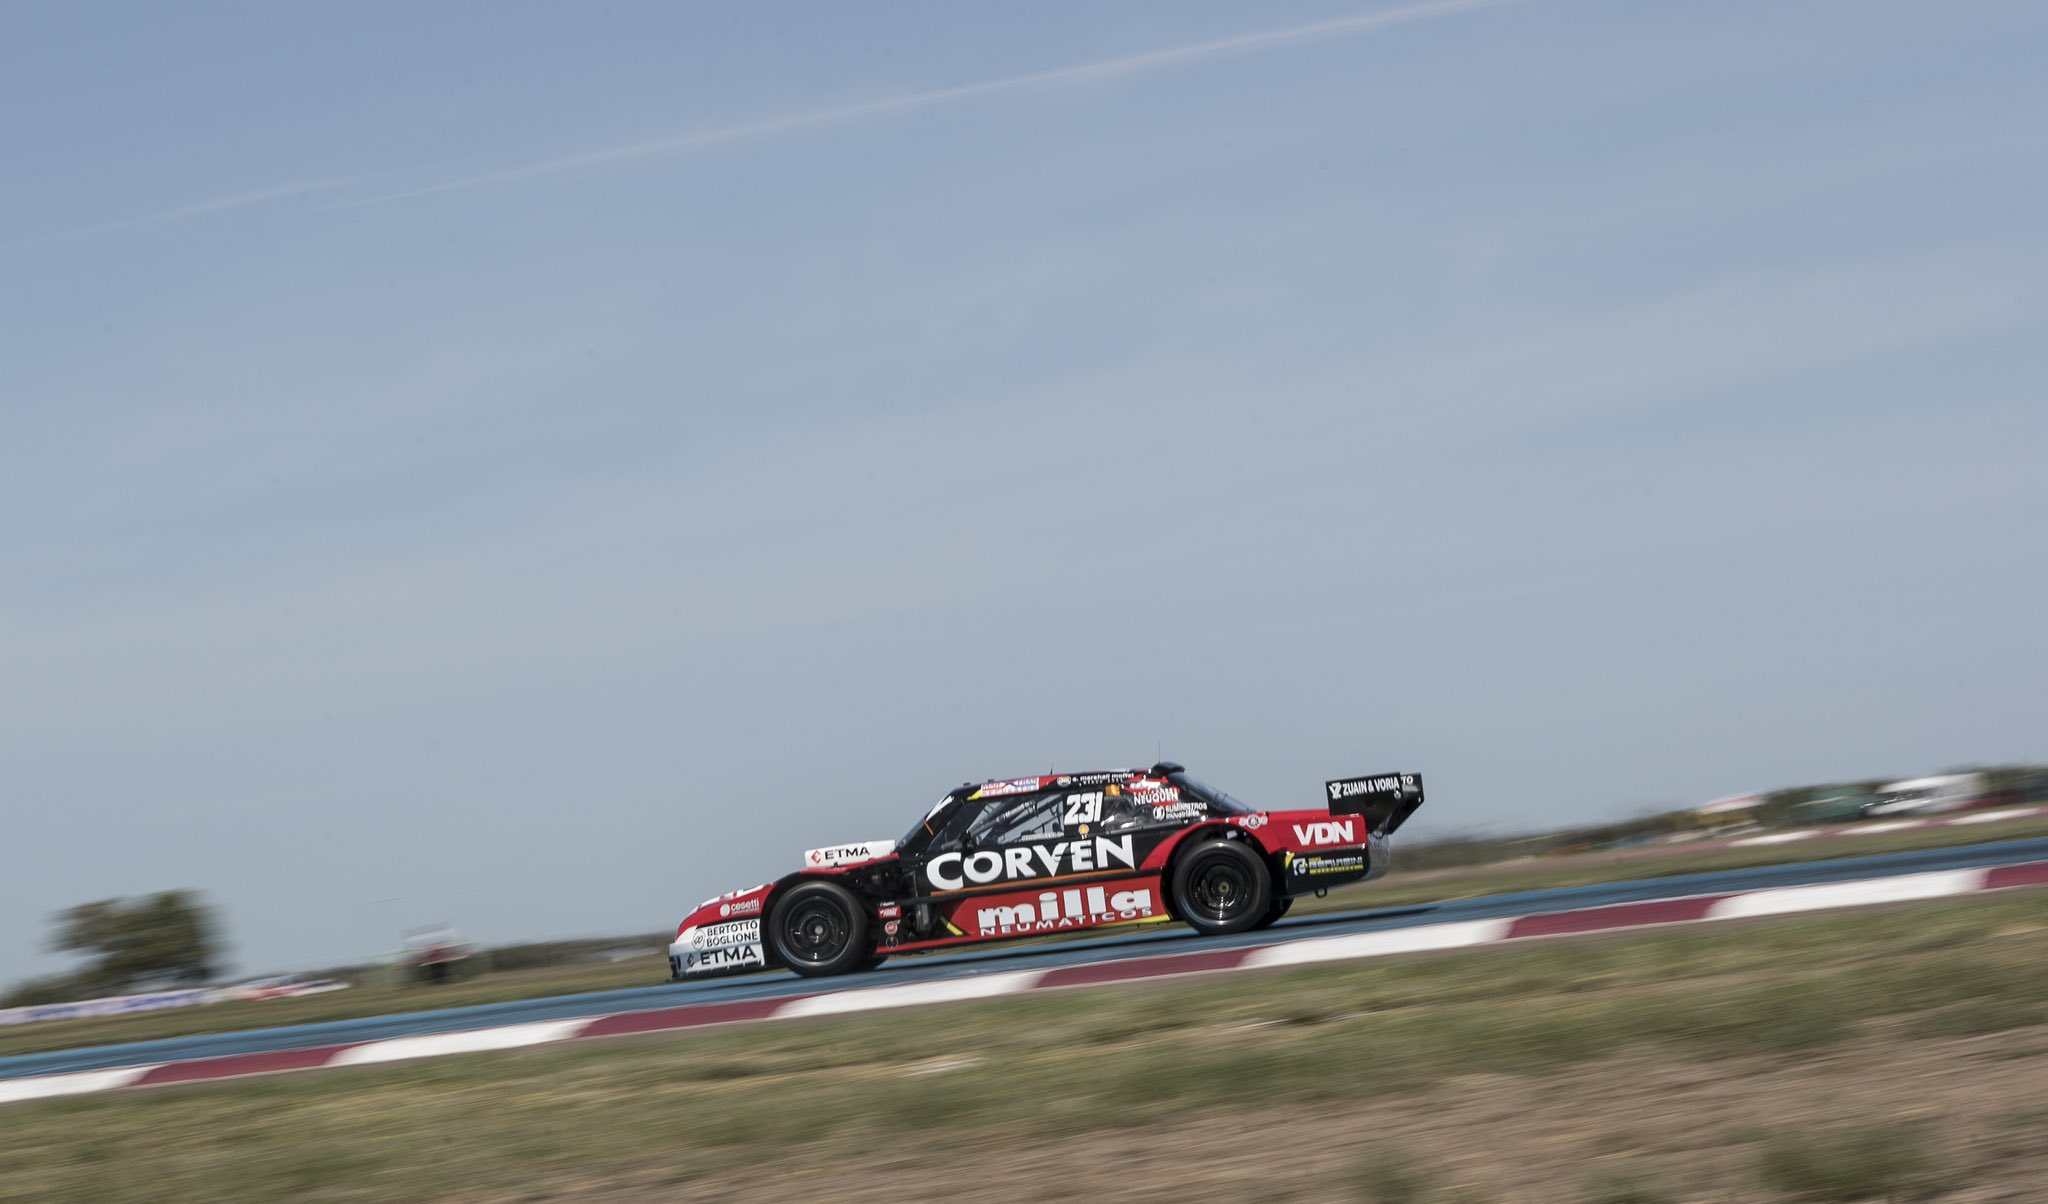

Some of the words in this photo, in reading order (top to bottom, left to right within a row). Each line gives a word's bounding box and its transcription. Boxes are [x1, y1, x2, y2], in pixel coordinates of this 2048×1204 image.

[1342, 780, 1367, 797] ZUAIN
[1367, 779, 1375, 793] &
[1374, 776, 1400, 794] VORIA
[1063, 791, 1104, 826] 231
[1293, 820, 1354, 846] VDN
[825, 846, 871, 860] ETMA
[926, 834, 1135, 891] CORVEN
[977, 886, 1151, 928] milla
[707, 919, 758, 937] BERTOTTO
[979, 907, 1152, 937] NEUMATICOS
[706, 931, 759, 948] BOGLIONE
[700, 945, 758, 966] ETMA
